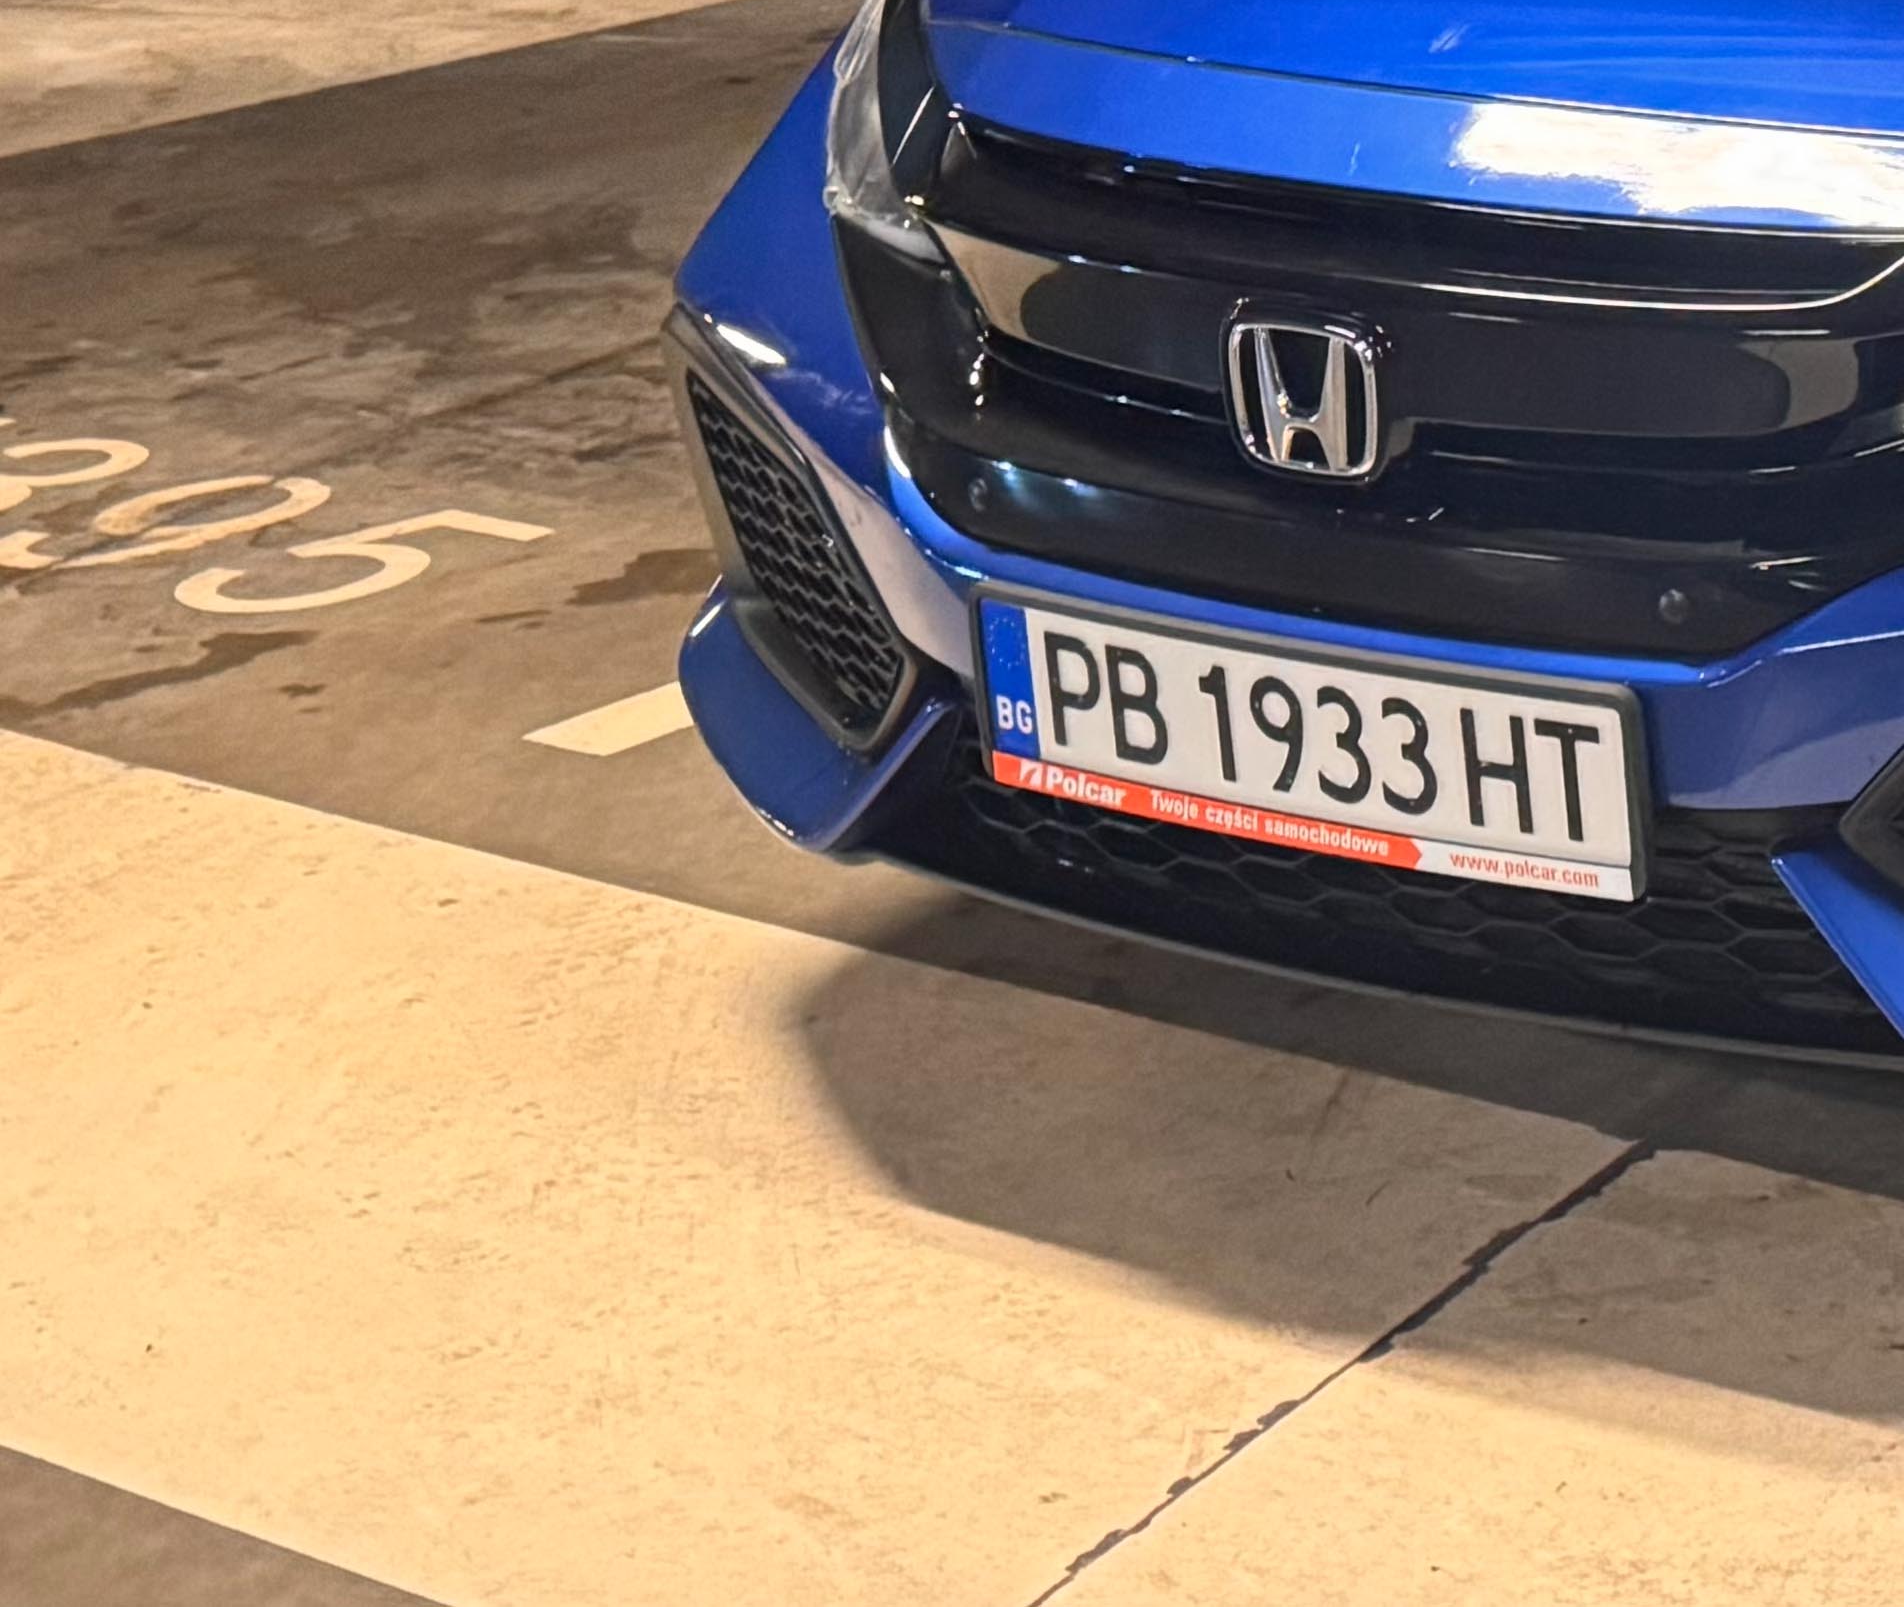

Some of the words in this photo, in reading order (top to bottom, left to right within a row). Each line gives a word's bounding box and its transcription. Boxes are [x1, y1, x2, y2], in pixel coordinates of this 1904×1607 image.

[995, 694, 1034, 734] BG
[1044, 631, 1168, 765] PB
[1198, 664, 1438, 815] 1933
[1459, 706, 1600, 842] HT
[1046, 769, 1126, 807] Polcar
[1150, 788, 1199, 820] Twoje
[1205, 804, 1259, 832] części
[1264, 817, 1389, 856] samochodowe
[1449, 850, 1600, 889] www.polcar.com
